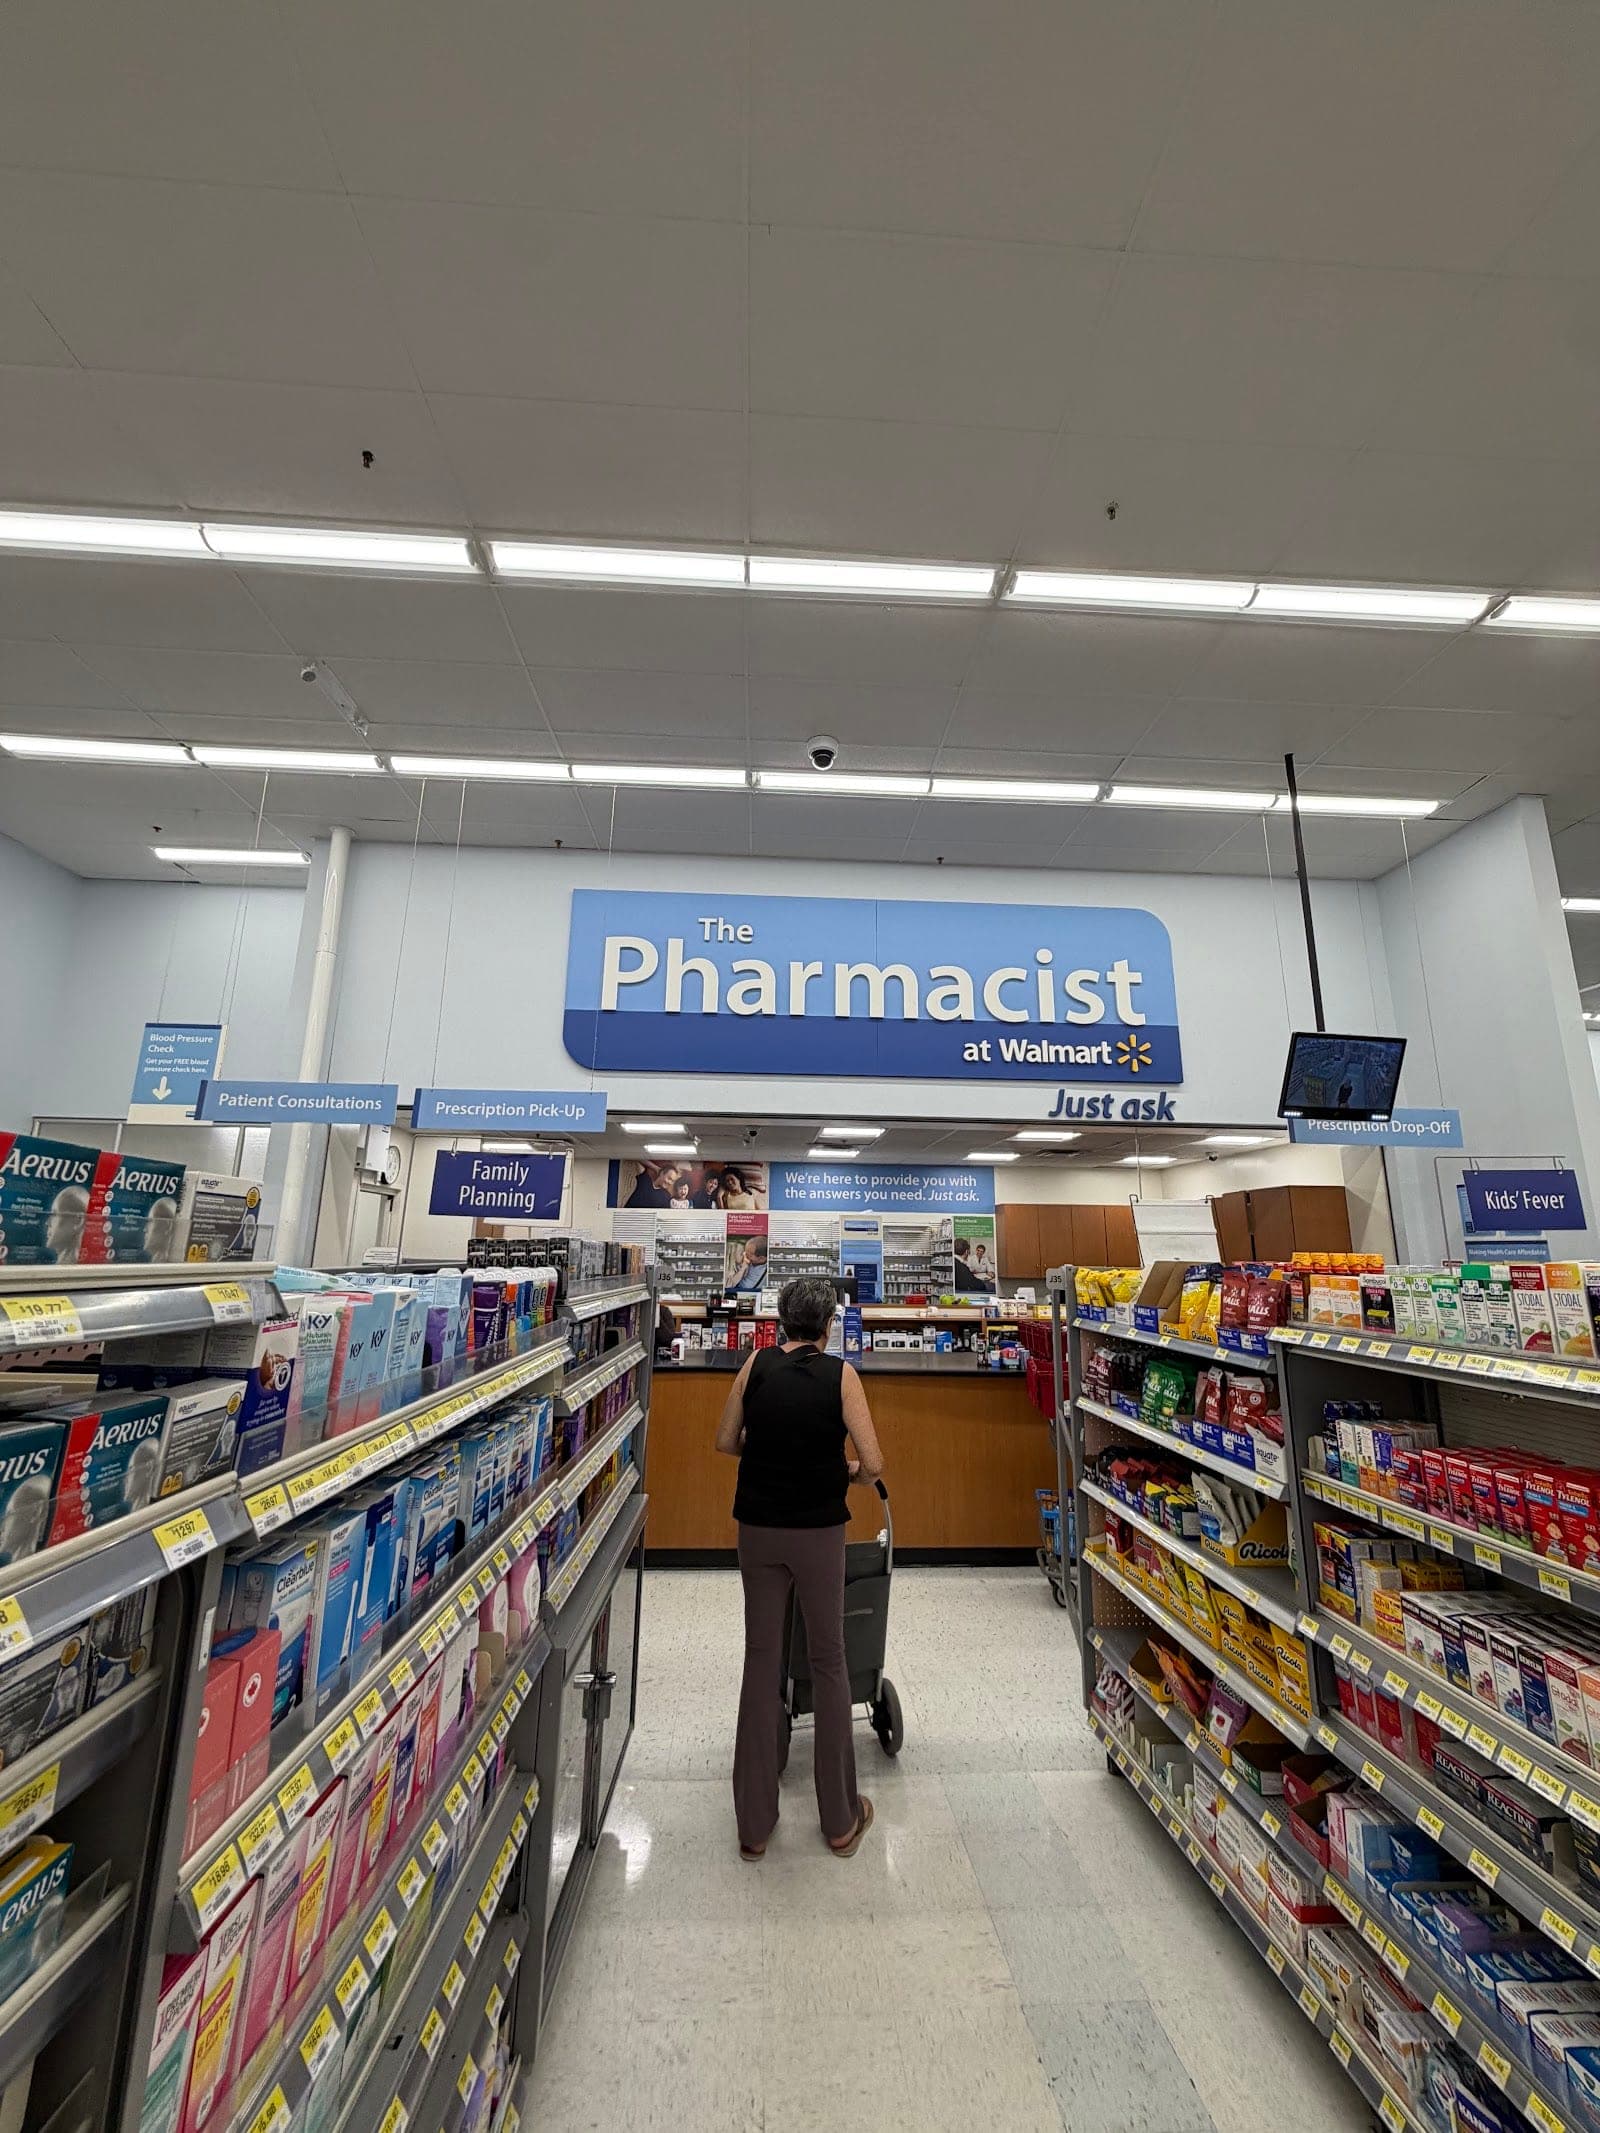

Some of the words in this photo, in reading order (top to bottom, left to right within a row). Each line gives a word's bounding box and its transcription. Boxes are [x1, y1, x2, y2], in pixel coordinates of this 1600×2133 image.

[698, 916, 754, 944] The
[601, 934, 1146, 1027] Pharmacist
[150, 1033, 176, 1042] Blood
[177, 1034, 213, 1043] Pressure
[147, 1044, 175, 1053] Check
[962, 1039, 992, 1062] at
[998, 1037, 1113, 1065] Walmart
[218, 1092, 274, 1108] Patient
[277, 1094, 382, 1111] Consultations
[435, 1101, 525, 1118] Prescription
[529, 1103, 586, 1121] Pick-Up
[1048, 1088, 1115, 1119] Just
[1120, 1090, 1177, 1121] ask
[1307, 1118, 1388, 1134] Prescription
[1391, 1119, 1451, 1136] Drop-Off
[471, 1159, 530, 1186] Family
[785, 1171, 821, 1185] We're
[823, 1172, 851, 1185] here
[854, 1174, 868, 1185] to
[871, 1174, 920, 1188] provide
[922, 1176, 946, 1188] you
[948, 1175, 977, 1187] with
[458, 1185, 536, 1214] Planning
[784, 1188, 806, 1200] the
[809, 1190, 861, 1200] answers
[863, 1190, 888, 1203] you
[890, 1190, 926, 1201] need.
[927, 1190, 953, 1201] Just
[955, 1190, 980, 1201] ask.
[1484, 1190, 1520, 1210] Kids'
[1523, 1191, 1566, 1210] Fever
[657, 1273, 671, 1281] J36
[1049, 1275, 1062, 1284] J35
[1394, 1281, 1406, 1289] 0-9
[1414, 1281, 1428, 1290] 0-9
[1438, 1292, 1453, 1302] 0-9
[1464, 1286, 1479, 1294] 0-9
[1516, 1293, 1545, 1307] STODAL
[1553, 1292, 1583, 1308] STODAL
[1256, 1447, 1279, 1464] equate
[1524, 1480, 1555, 1497] TYLENOL
[1556, 1489, 1591, 1507] TYLENOL
[276, 1560, 315, 1594] Clearblue
[1191, 1615, 1214, 1640] Ricola
[1222, 1637, 1247, 1661] Ricola
[1276, 1645, 1302, 1673] Ricola
[1519, 1652, 1543, 1673] BENYLIN
[1247, 1660, 1275, 1689] Ricola
[1279, 1687, 1309, 1718] Ricola
[1199, 1728, 1222, 1757] Ricola
[1435, 1751, 1480, 1790] REACTINE
[1486, 1790, 1535, 1834] REACTINE
[1309, 1938, 1338, 1977] Cepacol
